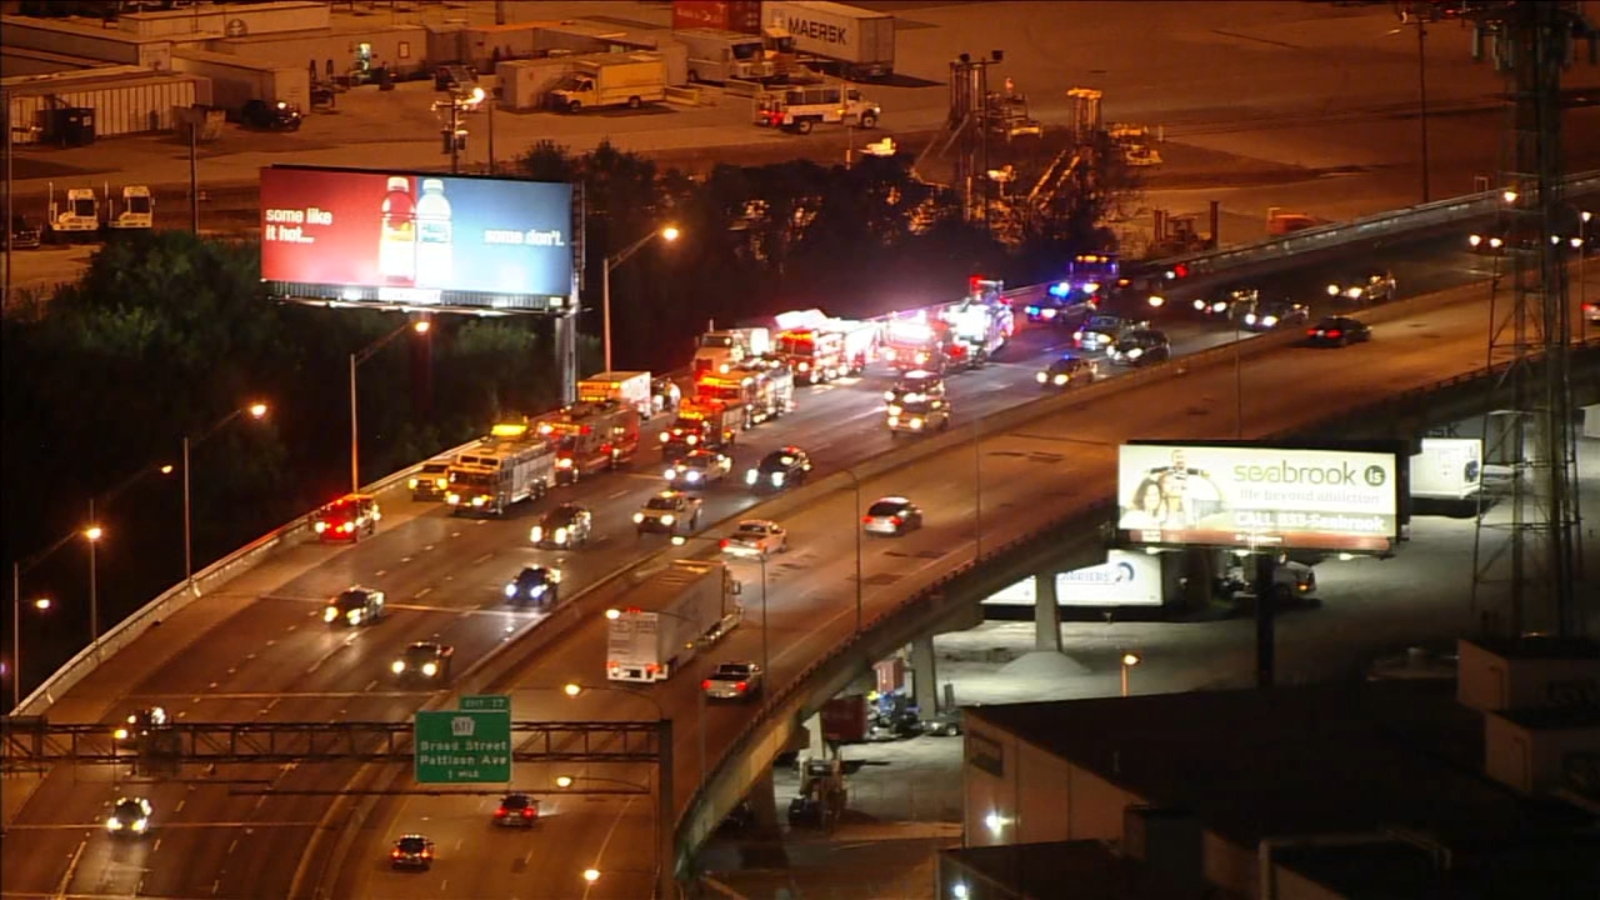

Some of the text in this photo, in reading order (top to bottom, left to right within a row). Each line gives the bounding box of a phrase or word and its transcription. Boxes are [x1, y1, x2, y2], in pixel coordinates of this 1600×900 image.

[788, 17, 847, 45] MAERSK
[266, 208, 333, 225] some like
[266, 225, 276, 241] it
[485, 229, 523, 243] some
[1234, 460, 1356, 486] seabrook
[420, 741, 507, 751] Broad Street
[481, 755, 507, 766] Ave
